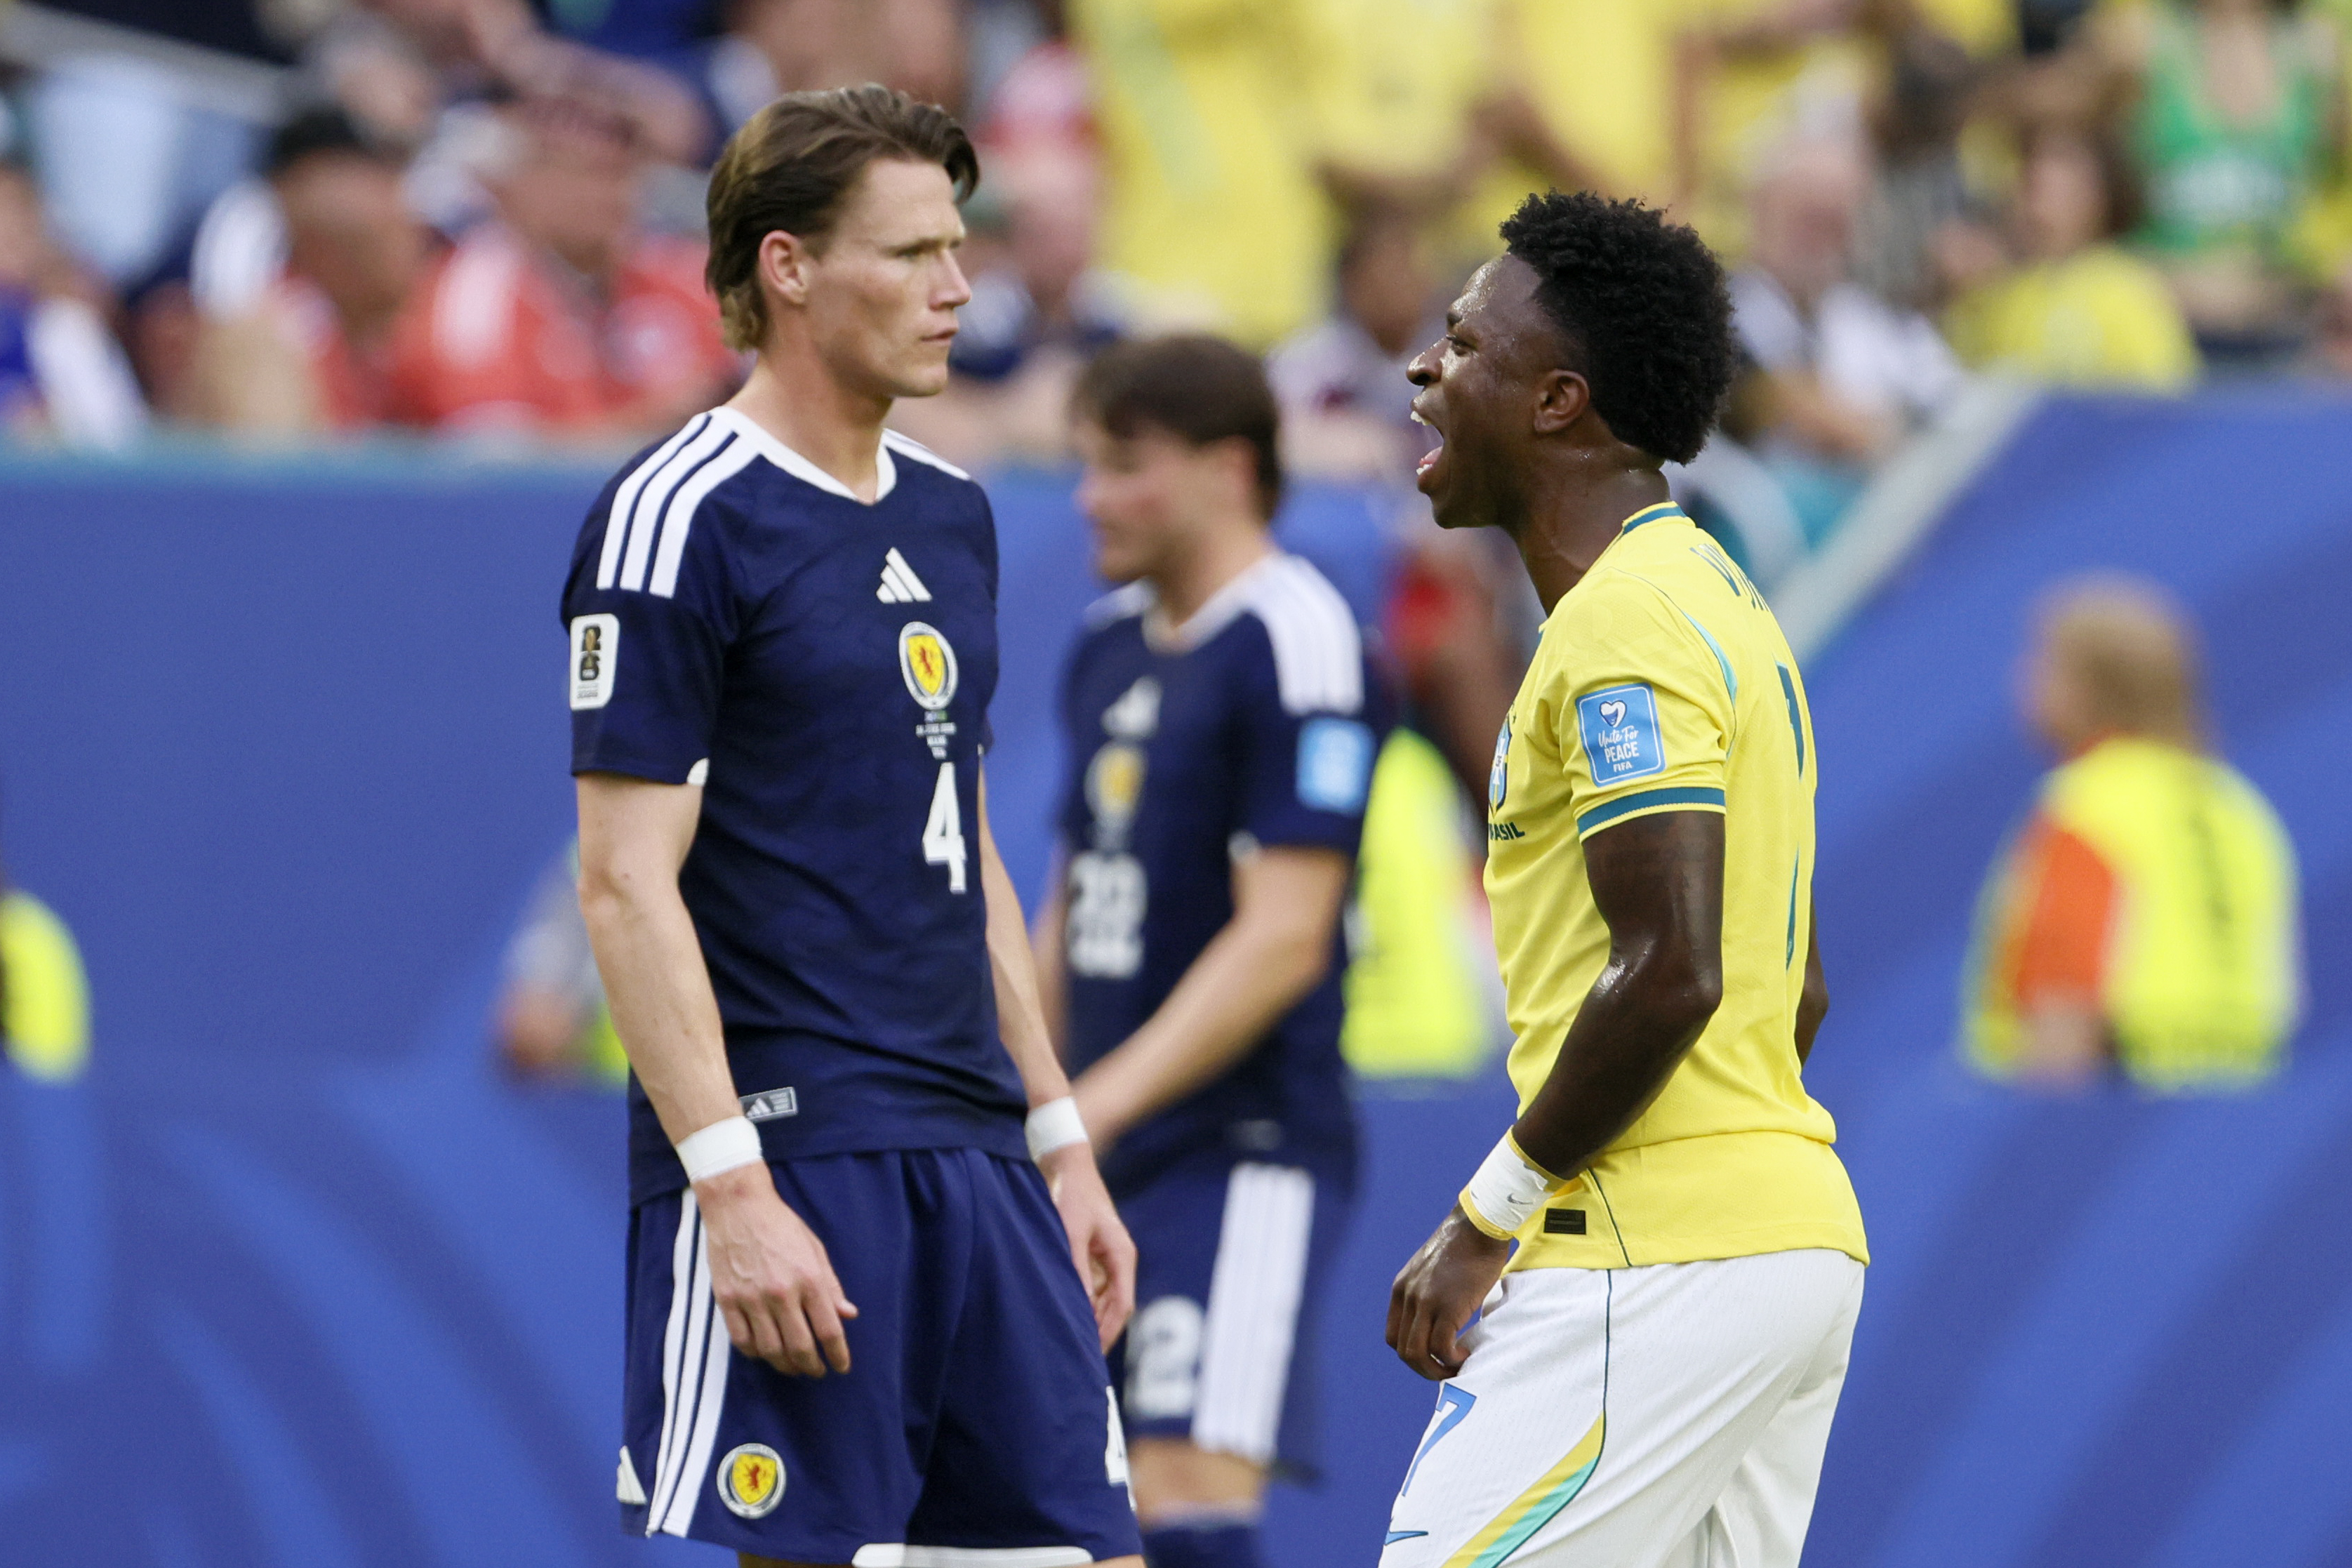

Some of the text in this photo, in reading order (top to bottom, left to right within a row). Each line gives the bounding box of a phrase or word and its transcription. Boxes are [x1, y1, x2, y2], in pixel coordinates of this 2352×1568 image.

[1598, 725, 1639, 748] Unite For
[1604, 741, 1640, 764] PEACE
[1614, 761, 1633, 773] FIFA
[922, 762, 968, 895] 4
[1401, 1381, 1477, 1497] 7
